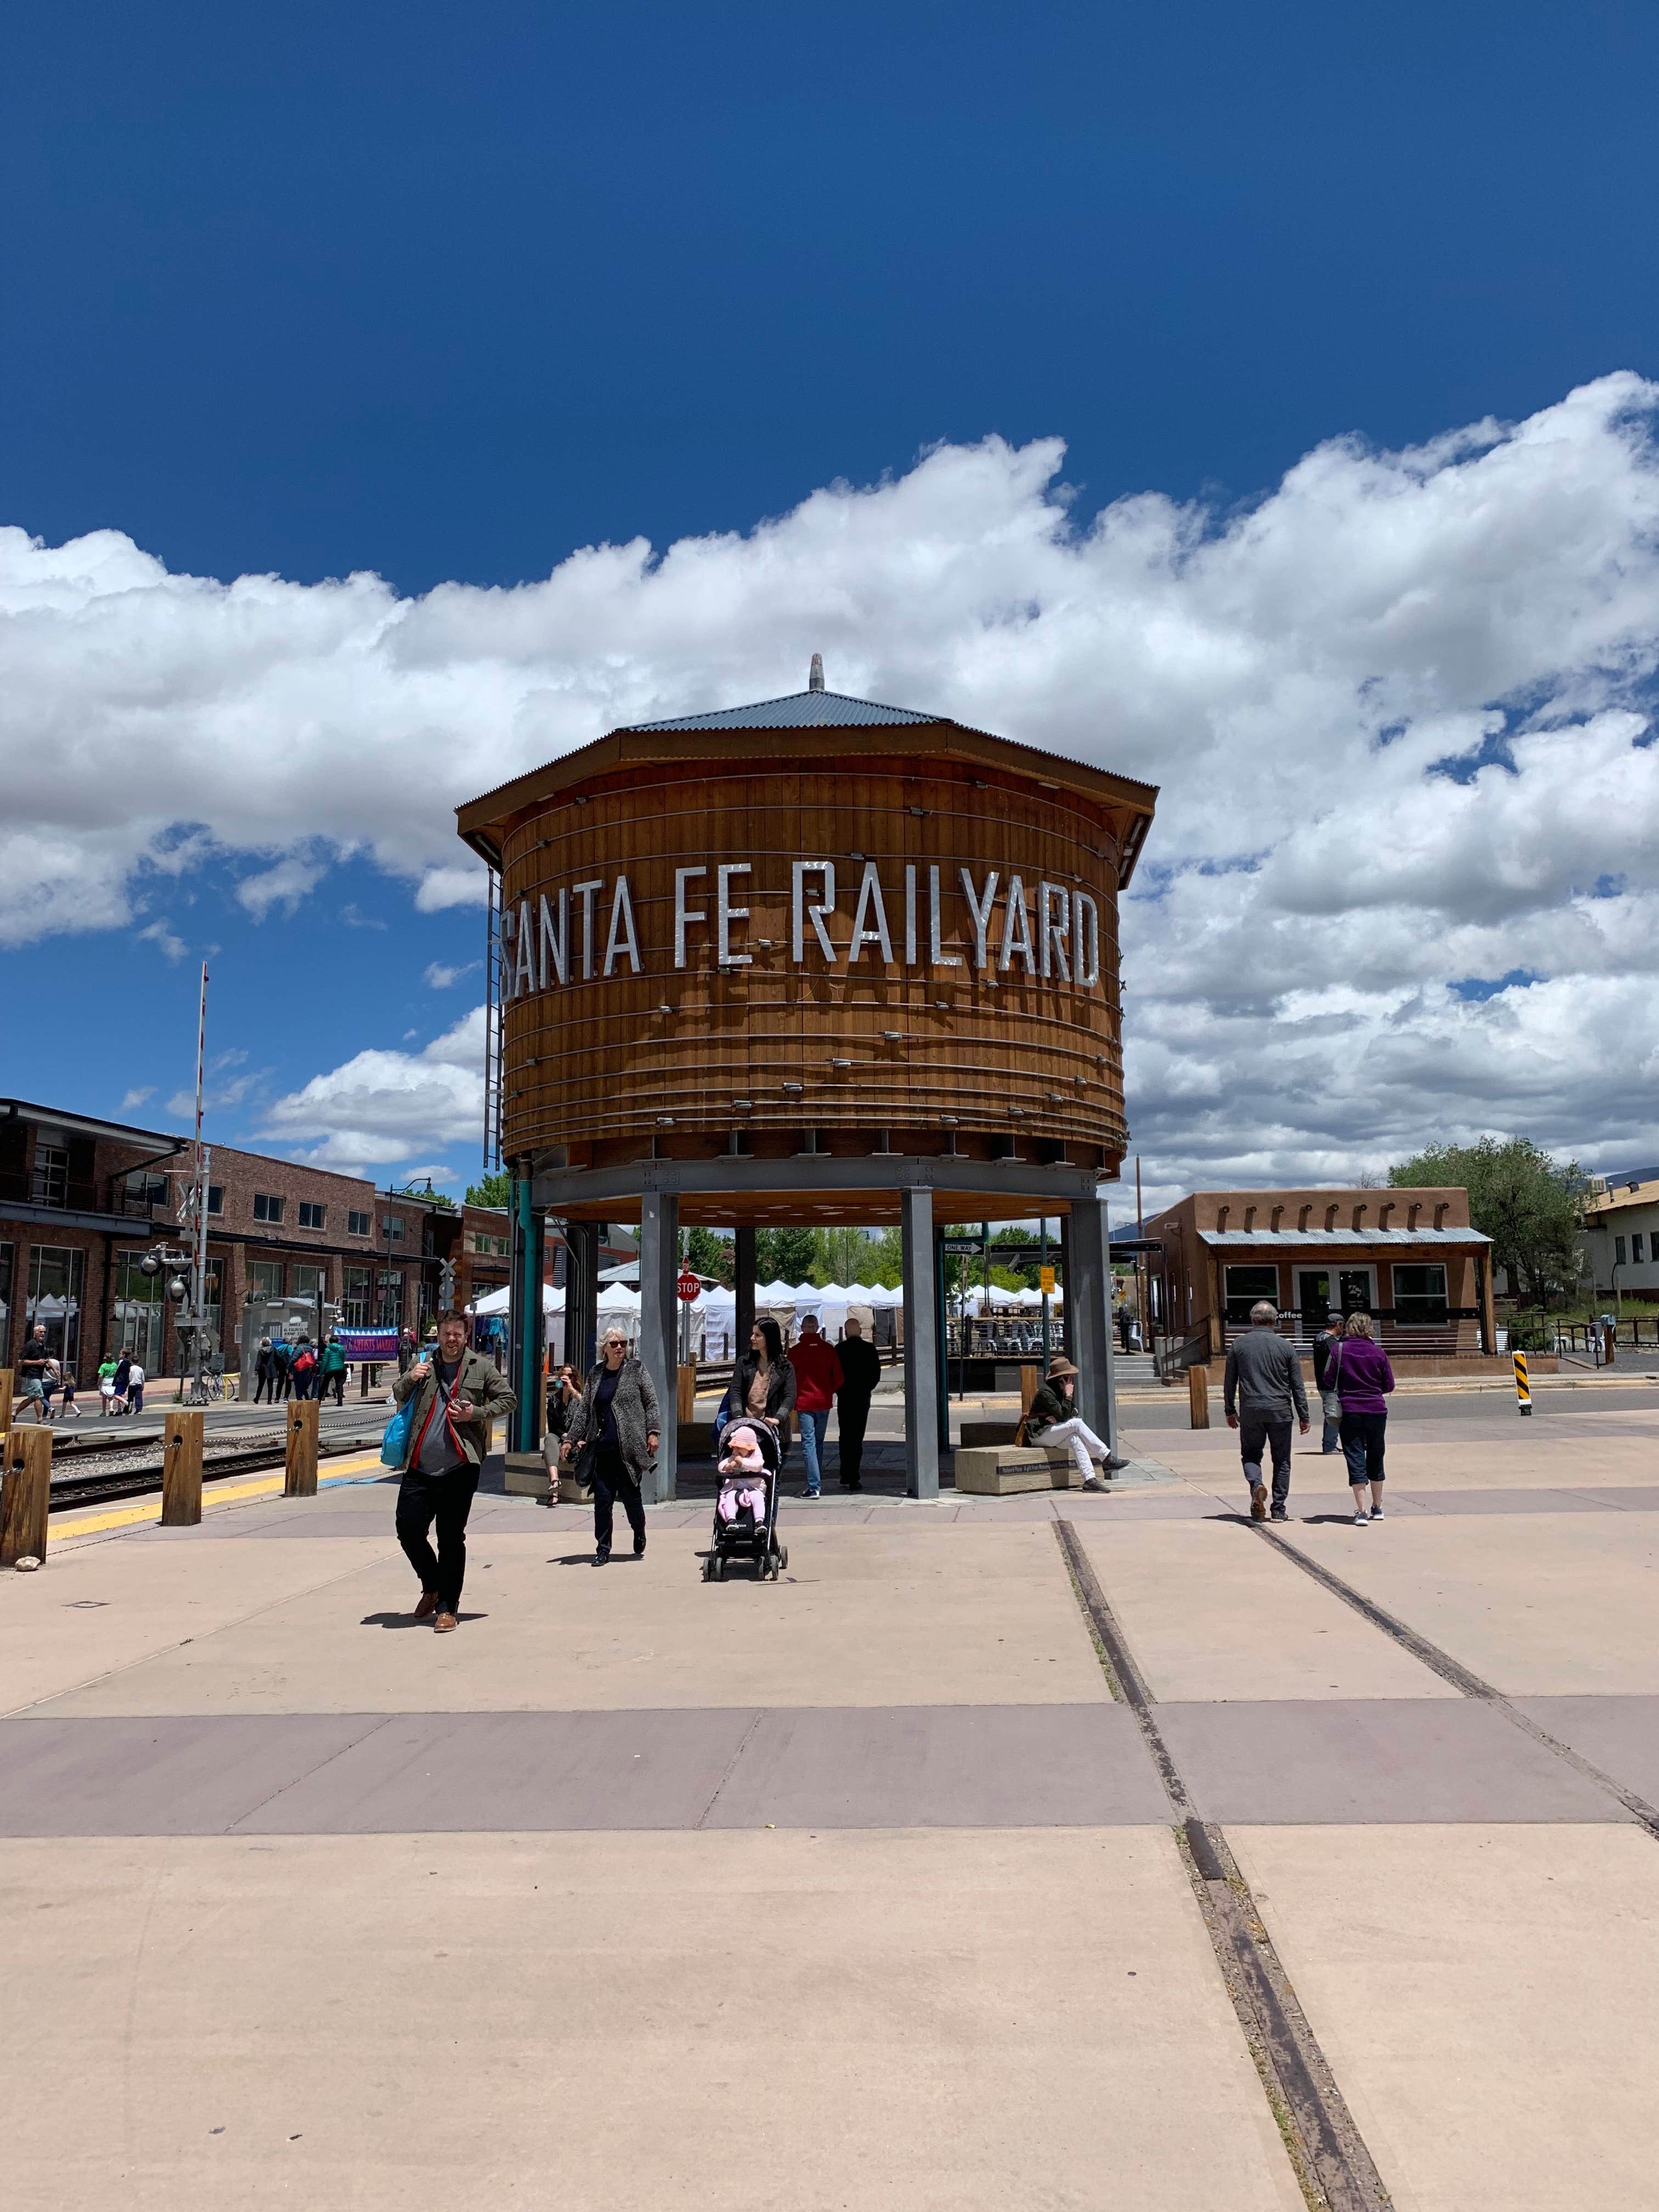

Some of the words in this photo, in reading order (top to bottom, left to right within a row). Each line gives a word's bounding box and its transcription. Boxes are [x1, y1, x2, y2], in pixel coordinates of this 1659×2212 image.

[499, 875, 645, 1005] SANTA
[674, 862, 753, 969] FE
[792, 861, 1099, 988] RAILYARD
[678, 1283, 699, 1293] STOP
[353, 1339, 375, 1351] ARTISTS
[376, 1339, 396, 1351] MARKET
